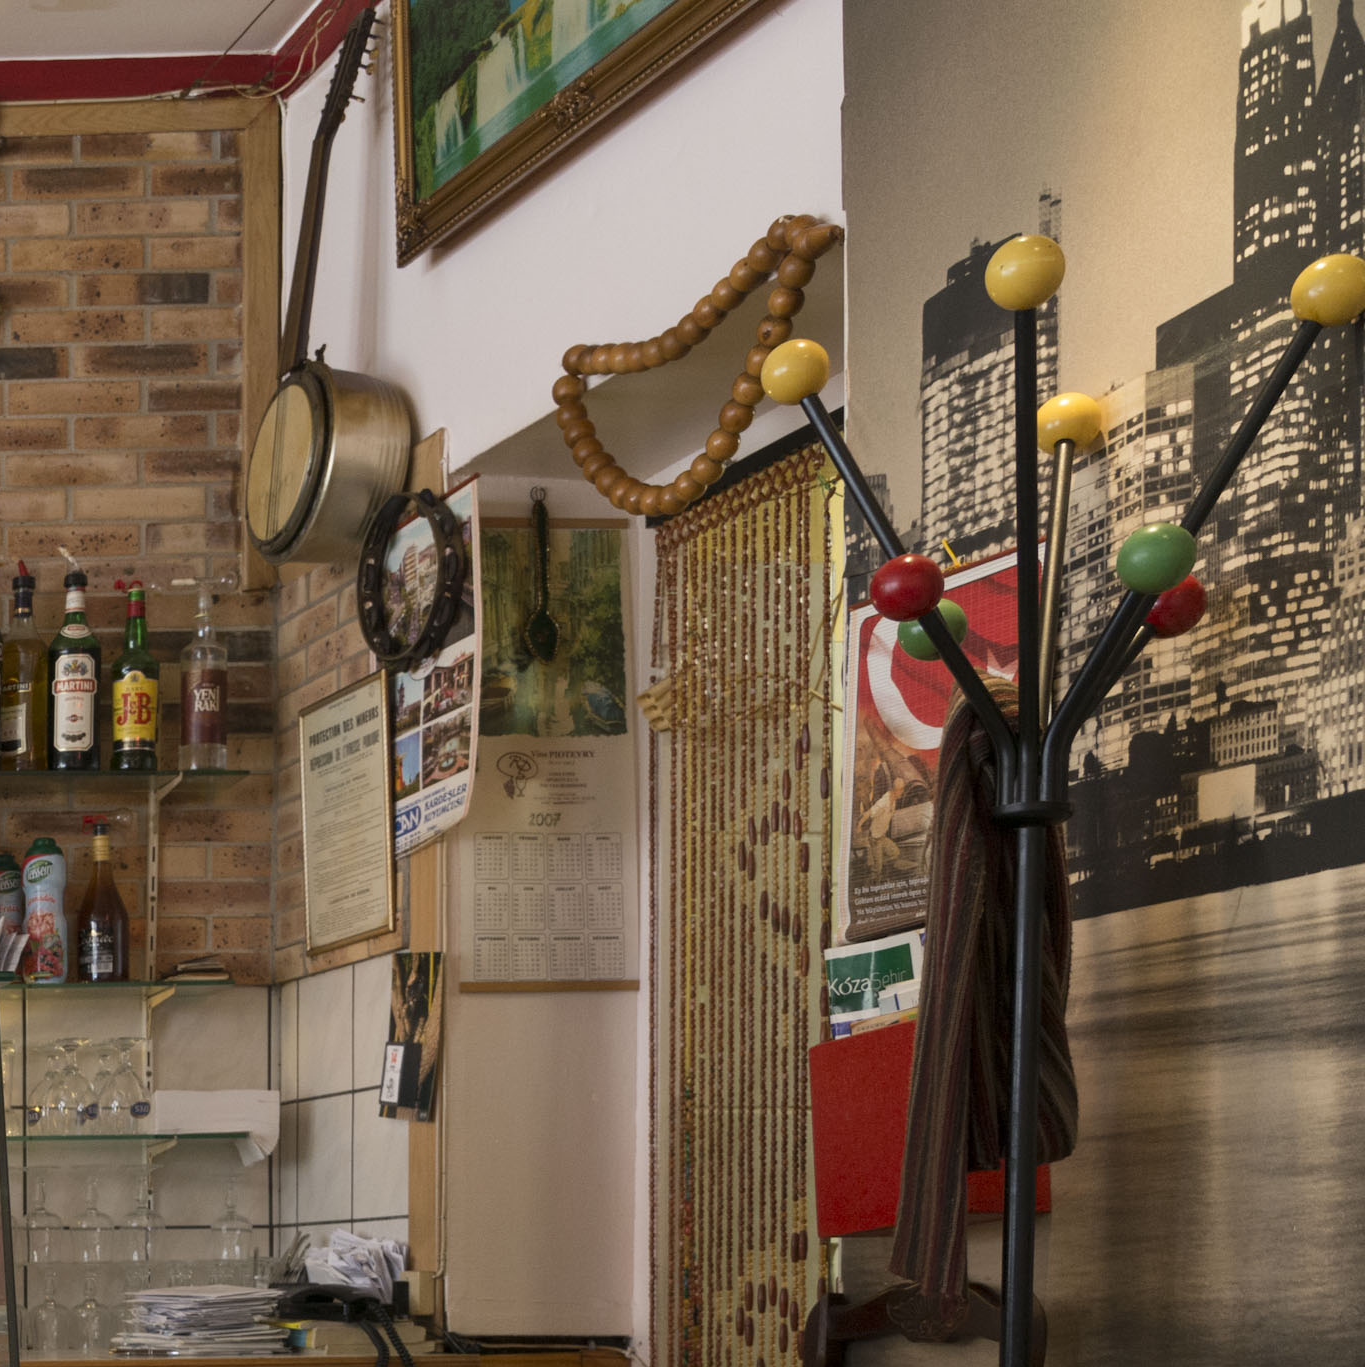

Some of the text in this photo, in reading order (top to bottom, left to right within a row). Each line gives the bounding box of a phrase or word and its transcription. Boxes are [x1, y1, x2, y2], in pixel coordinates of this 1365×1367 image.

[2, 682, 29, 690] ARTINI
[56, 680, 94, 692] MARTINI
[116, 692, 152, 726] J&B
[528, 812, 562, 827] 2007
